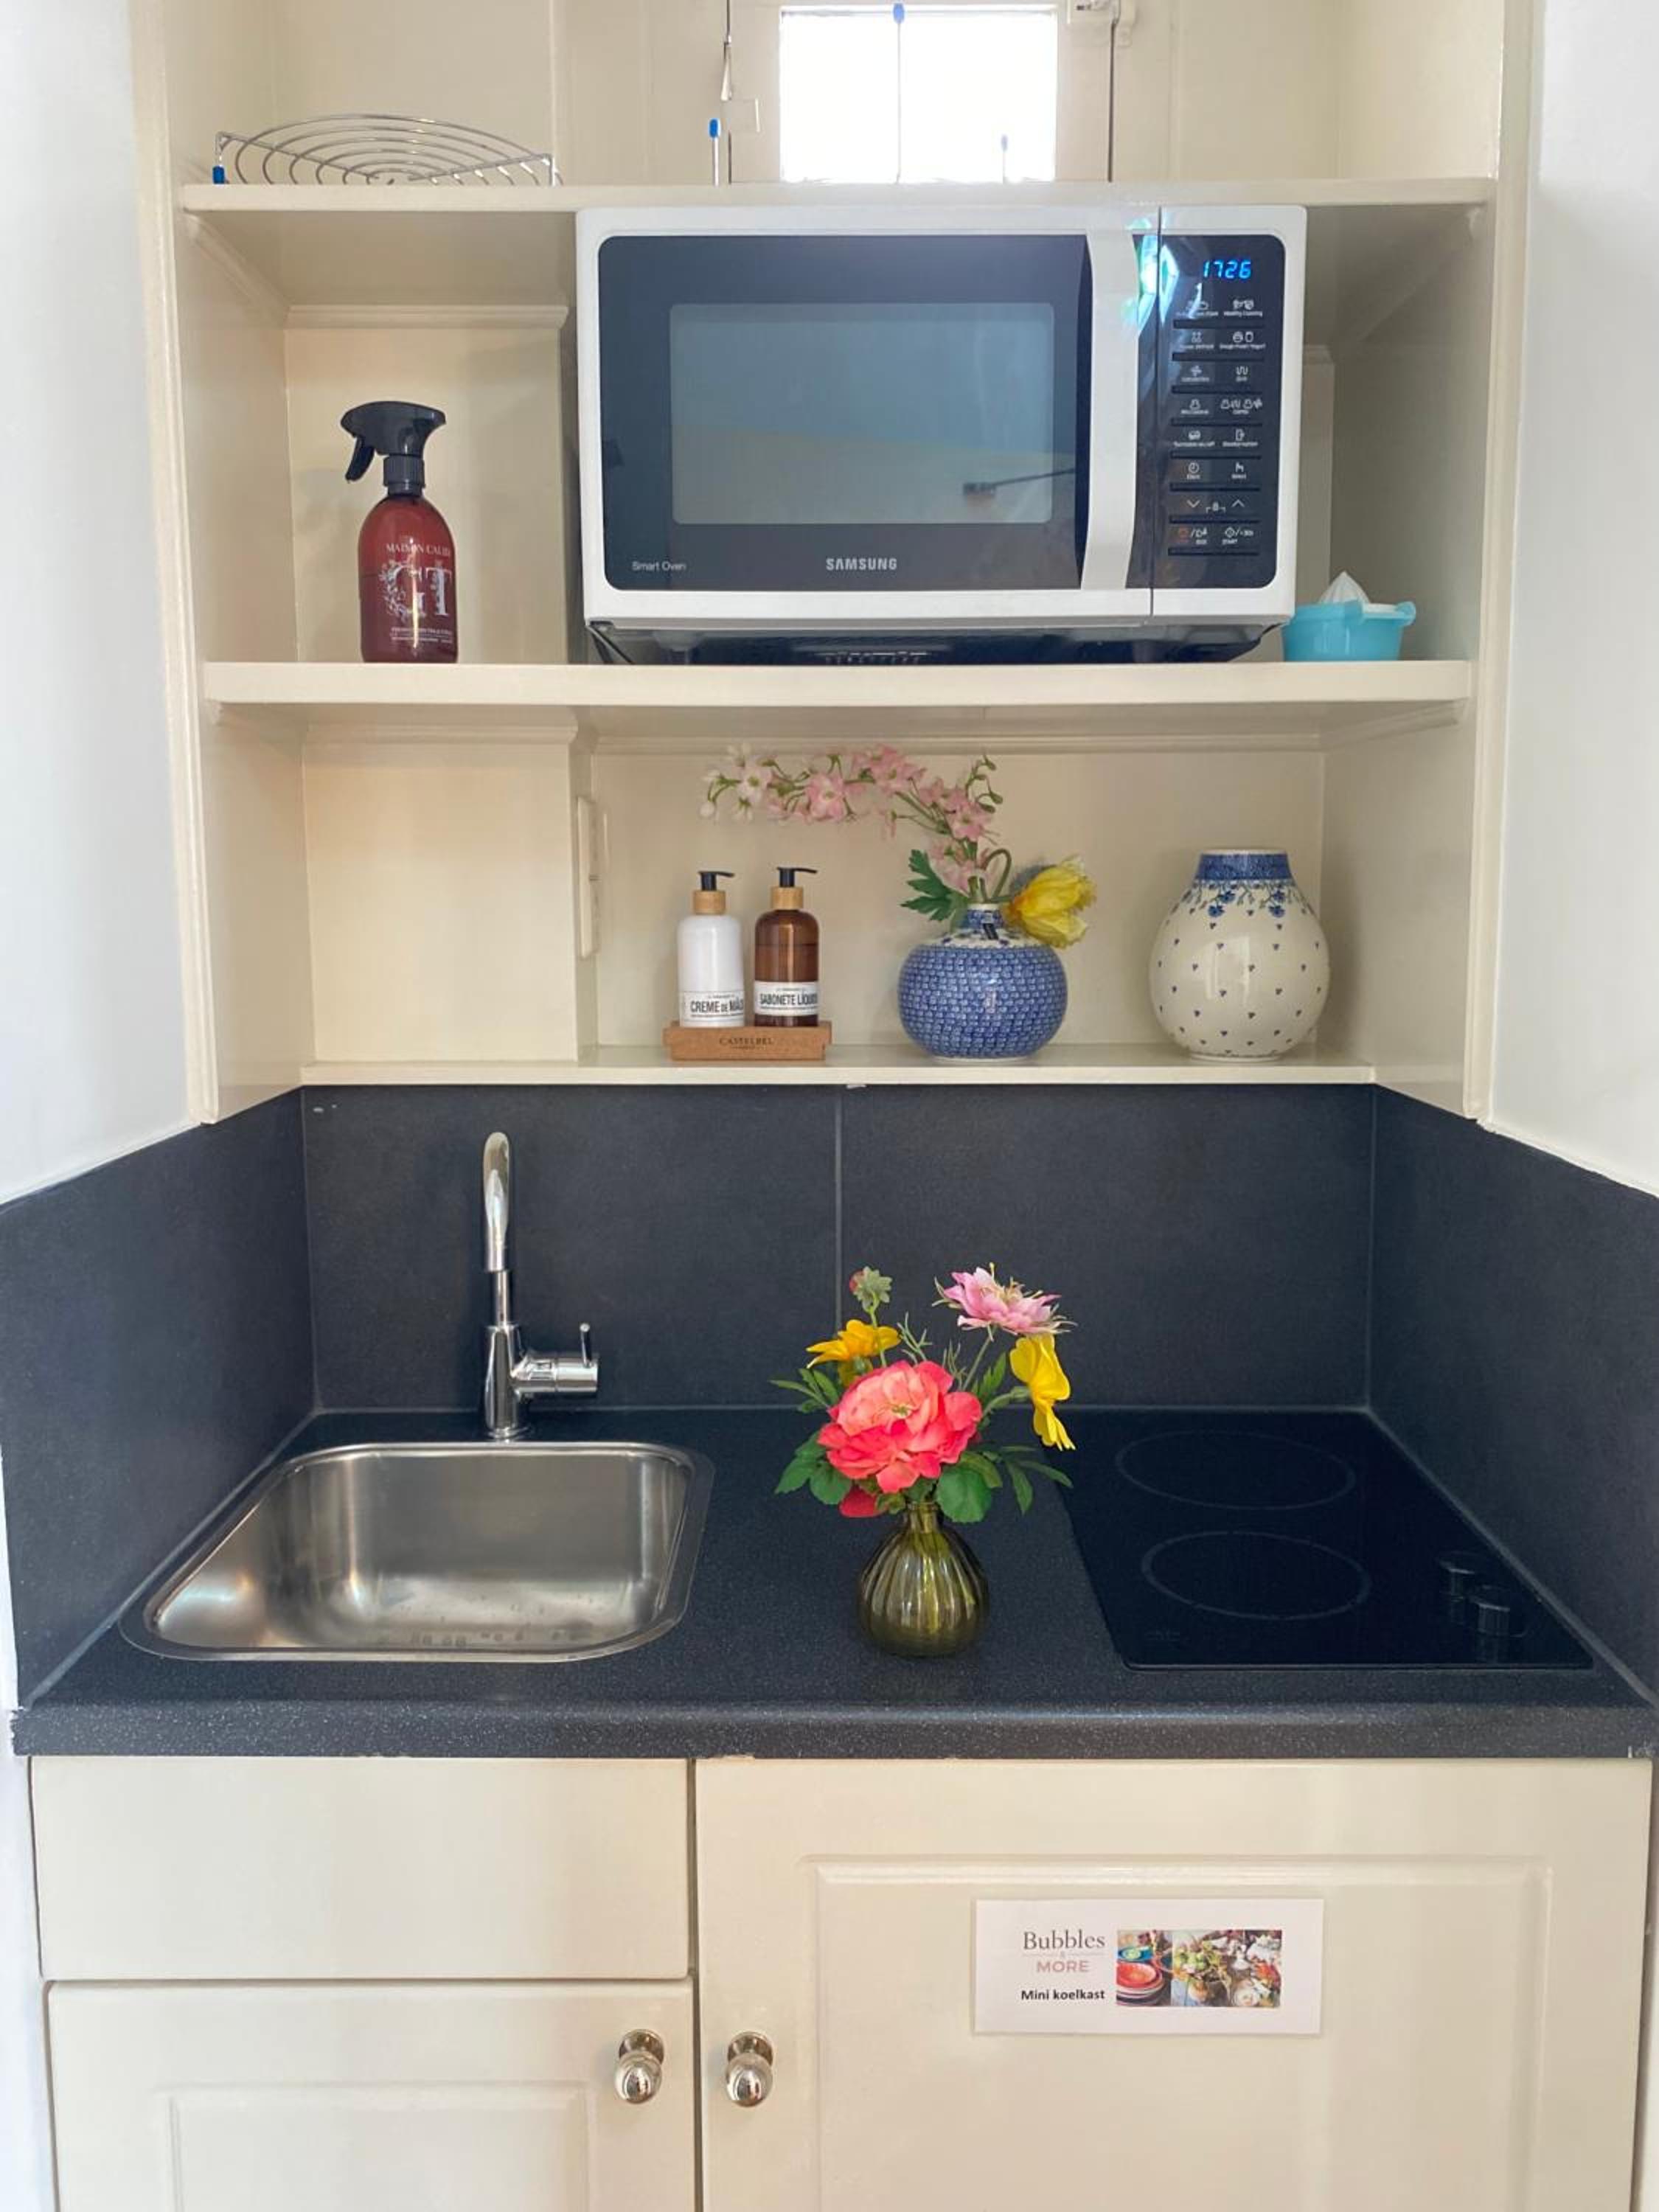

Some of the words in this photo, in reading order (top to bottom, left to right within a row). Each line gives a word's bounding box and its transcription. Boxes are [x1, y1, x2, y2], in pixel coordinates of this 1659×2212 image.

[1203, 260, 1252, 279] 1726
[631, 560, 660, 571] Smart
[662, 561, 686, 571] Oven
[825, 557, 897, 571] SAMSUNG
[759, 993, 796, 1006] SABONETE
[690, 1000, 720, 1013] CREME
[1023, 1928, 1106, 1950] Bubbles
[1036, 1960, 1091, 1973] MORE
[1020, 1989, 1049, 2001] Mini
[1052, 1989, 1106, 2001] koelkast
